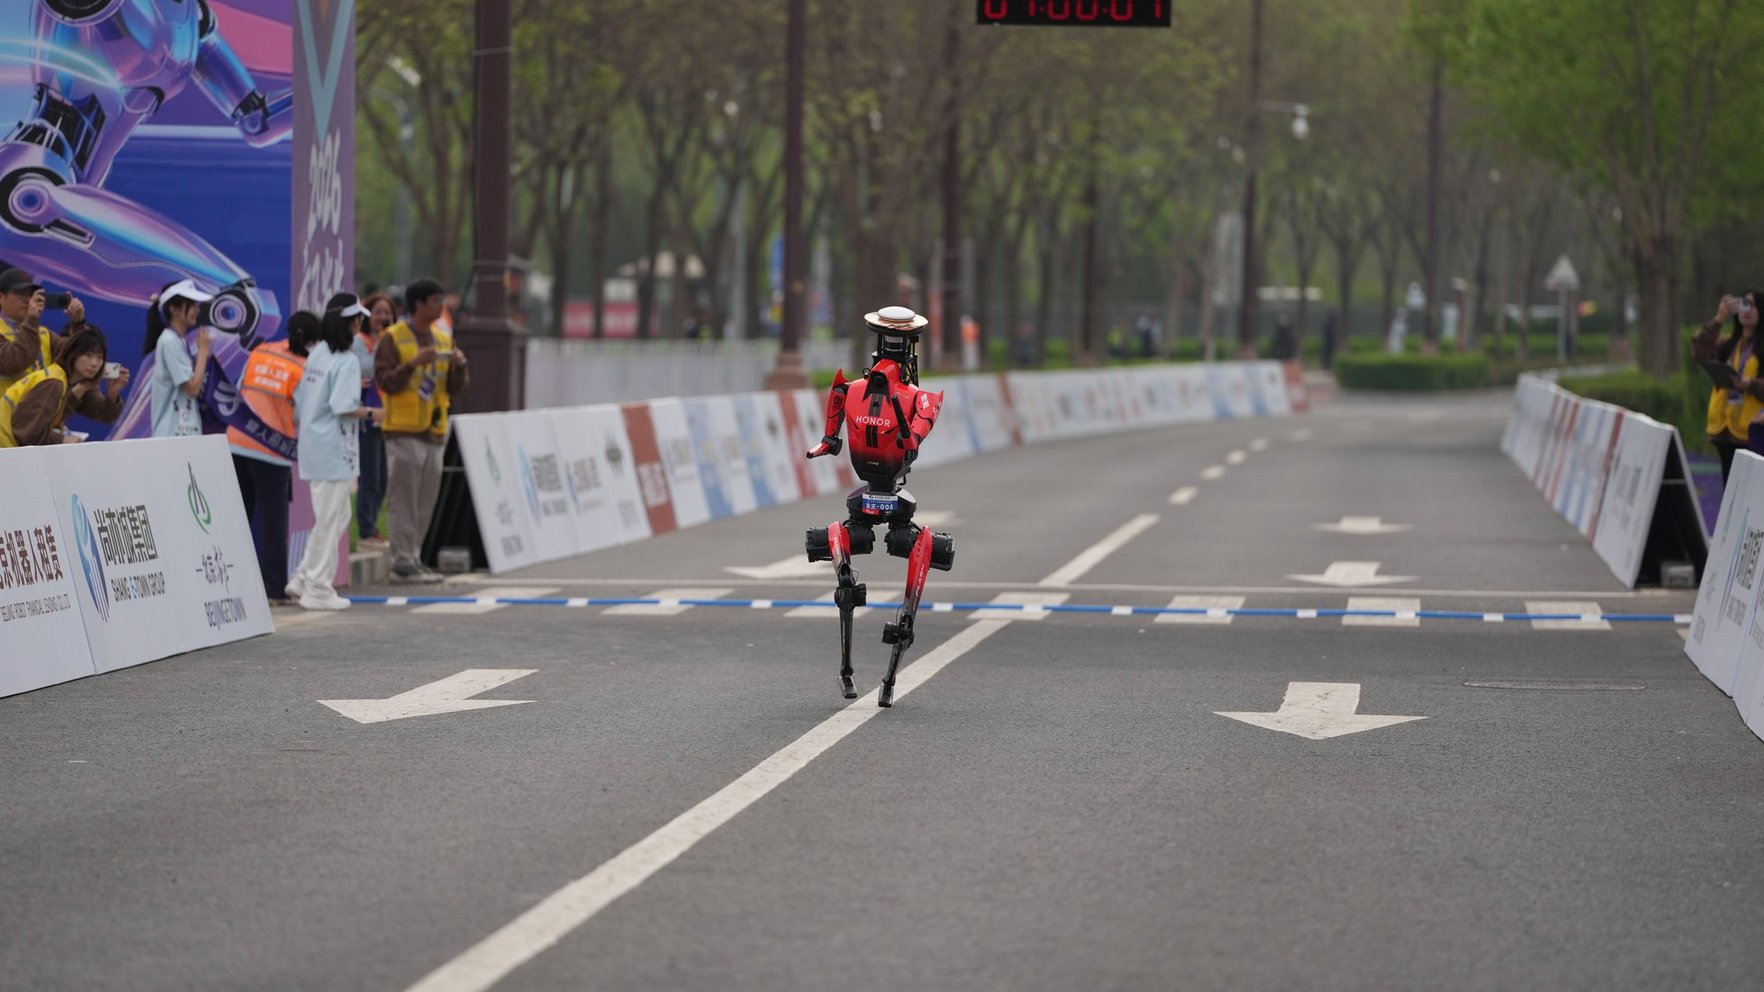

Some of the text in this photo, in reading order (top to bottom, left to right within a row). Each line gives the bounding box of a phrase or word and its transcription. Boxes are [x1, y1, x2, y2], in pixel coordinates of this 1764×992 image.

[855, 415, 891, 428] HONOR
[0, 525, 63, 590] 京机器人租赁
